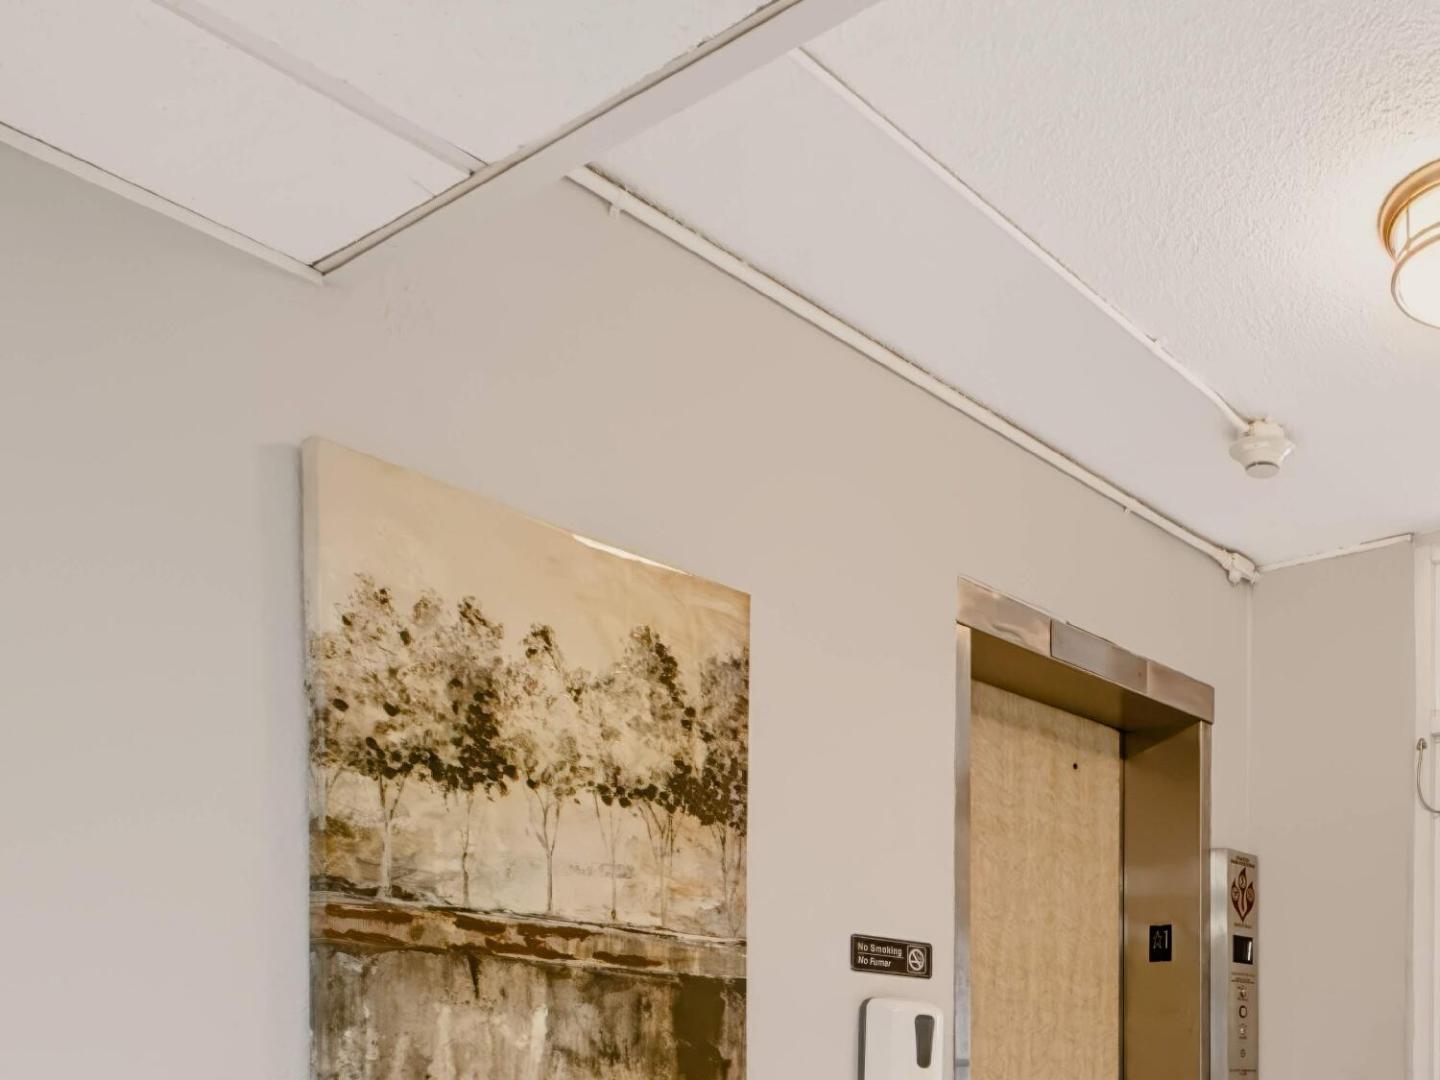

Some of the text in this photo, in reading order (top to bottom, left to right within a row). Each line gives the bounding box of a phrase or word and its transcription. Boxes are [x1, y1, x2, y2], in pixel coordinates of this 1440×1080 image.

[857, 942, 903, 958] No Smoking
[857, 955, 892, 968] No Fumar
